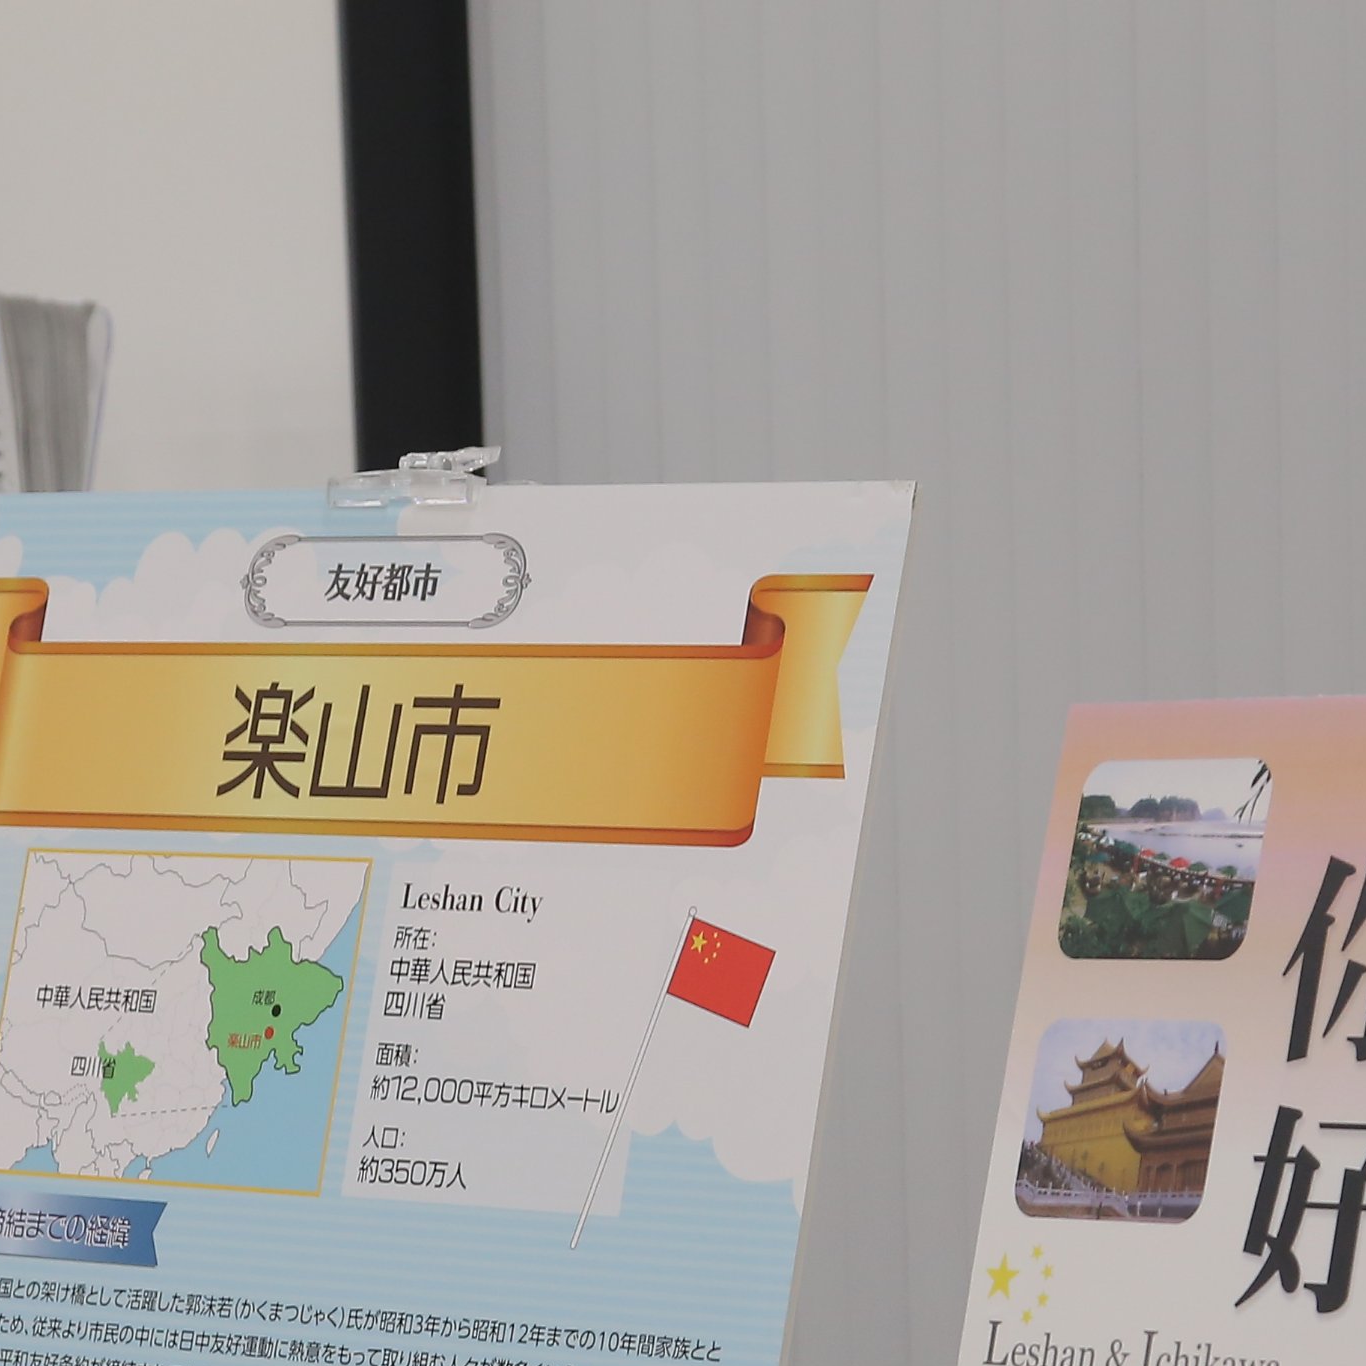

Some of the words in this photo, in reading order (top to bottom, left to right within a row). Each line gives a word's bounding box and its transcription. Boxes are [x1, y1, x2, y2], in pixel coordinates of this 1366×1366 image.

[324, 562, 442, 603] 友好都市
[216, 680, 502, 804] 楽山市
[401, 882, 484, 915] Leshan
[494, 886, 544, 923] City
[389, 957, 536, 991] 中華人民共和国
[36, 985, 157, 1015] 中華人民共和国
[251, 988, 276, 1006] 成都
[383, 991, 446, 1021] 四川省
[226, 1032, 263, 1051] 楽山市
[69, 1056, 116, 1081] 四川省
[370, 1074, 620, 1114] 約12,000平方キロメートル
[357, 1157, 467, 1190] 約350万人
